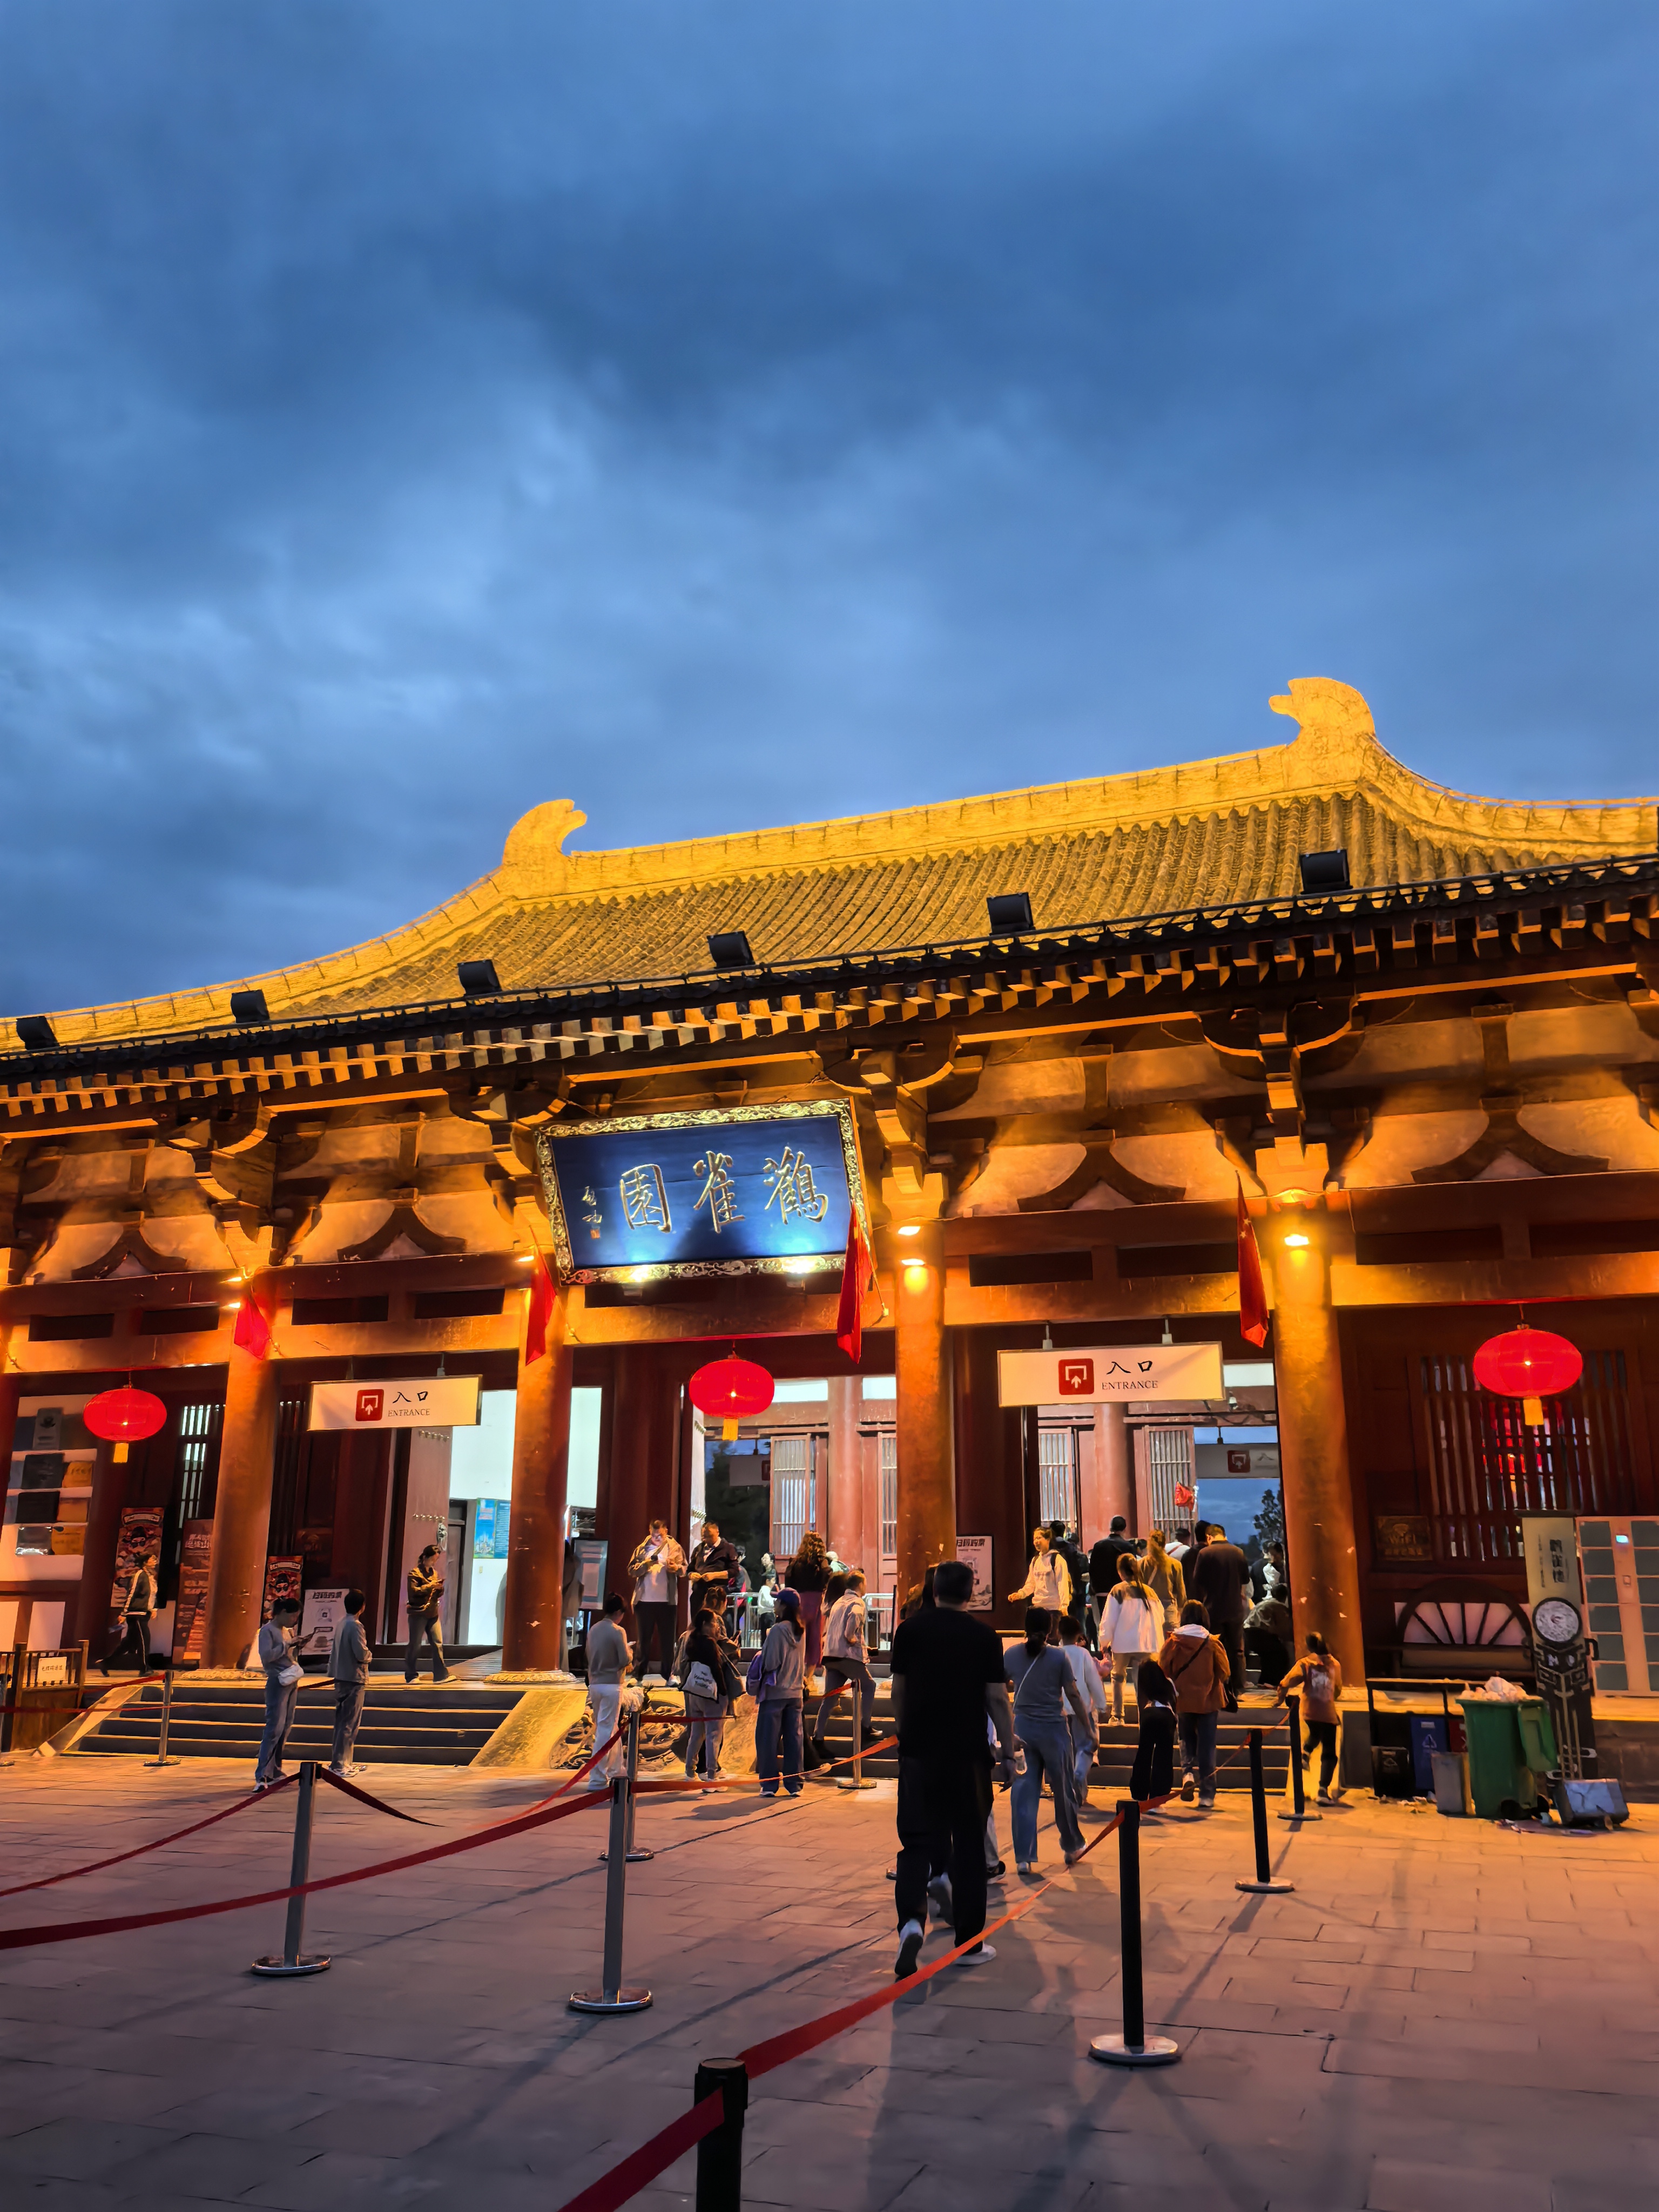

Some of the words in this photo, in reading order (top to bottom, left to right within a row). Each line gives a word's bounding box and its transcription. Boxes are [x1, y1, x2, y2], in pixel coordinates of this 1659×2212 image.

[1106, 1360, 1153, 1375] 入口
[1102, 1380, 1158, 1390] ENTRANCE
[393, 1391, 429, 1404] 入口
[388, 1408, 430, 1417] ENTRANCE
